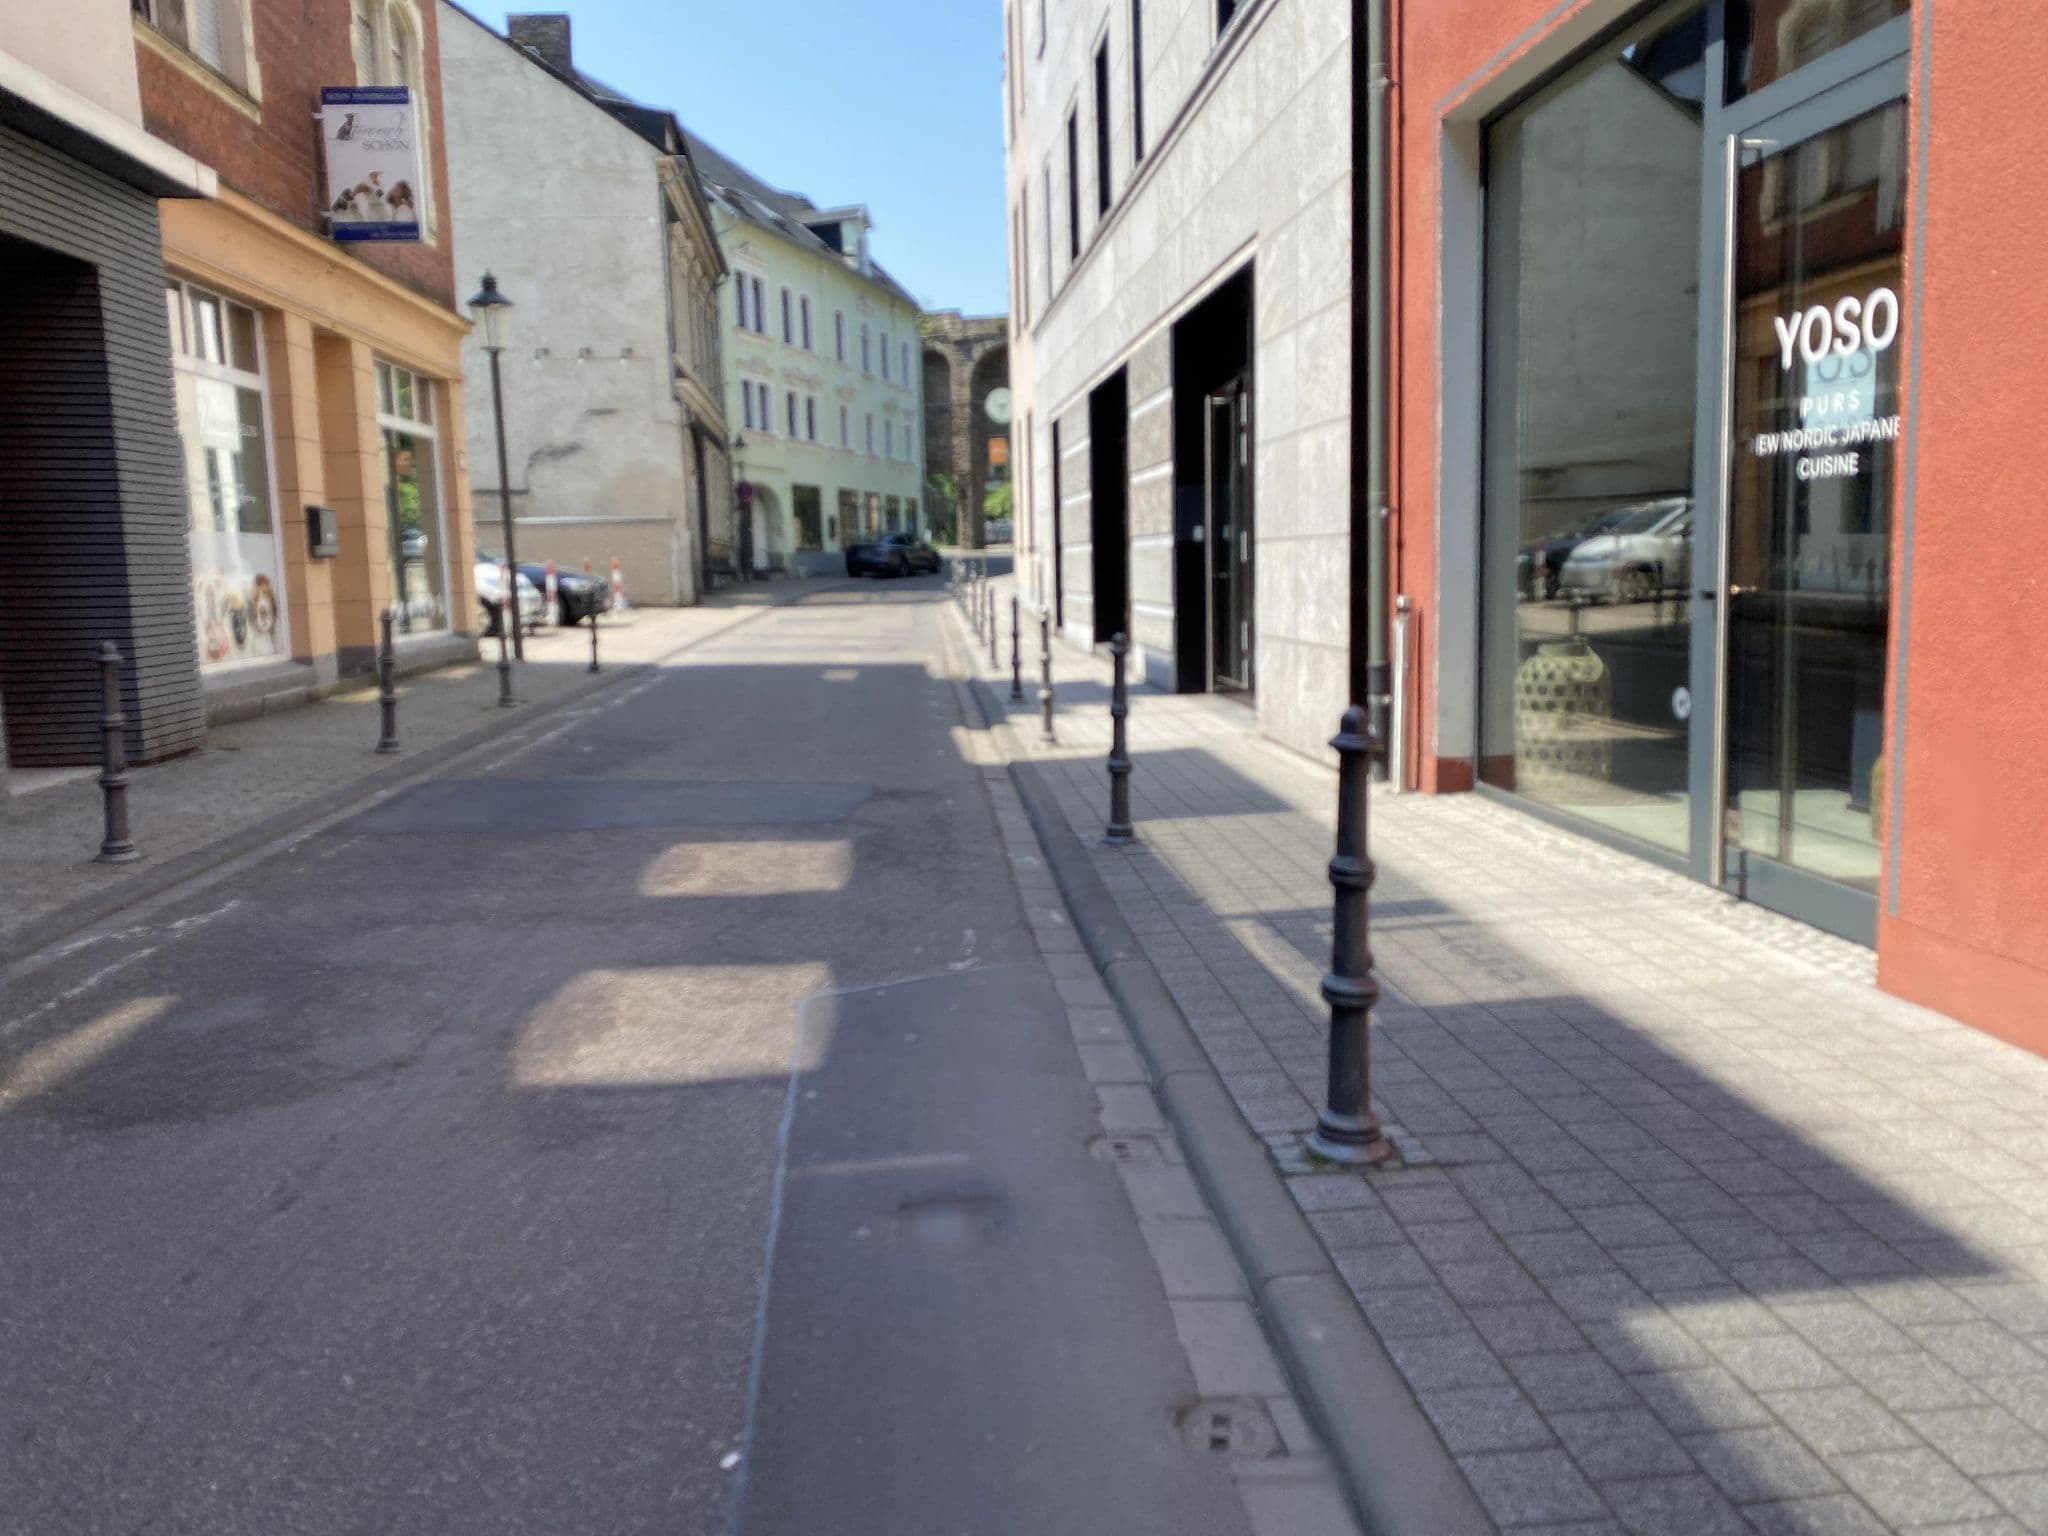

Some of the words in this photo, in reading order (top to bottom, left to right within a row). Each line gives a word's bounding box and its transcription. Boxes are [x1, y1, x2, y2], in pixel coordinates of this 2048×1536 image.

[1774, 287, 1899, 370] YOSO
[1799, 389, 1861, 417] PURS
[1780, 423, 1838, 451] NORDIC
[1797, 452, 1859, 480] CUISINE
